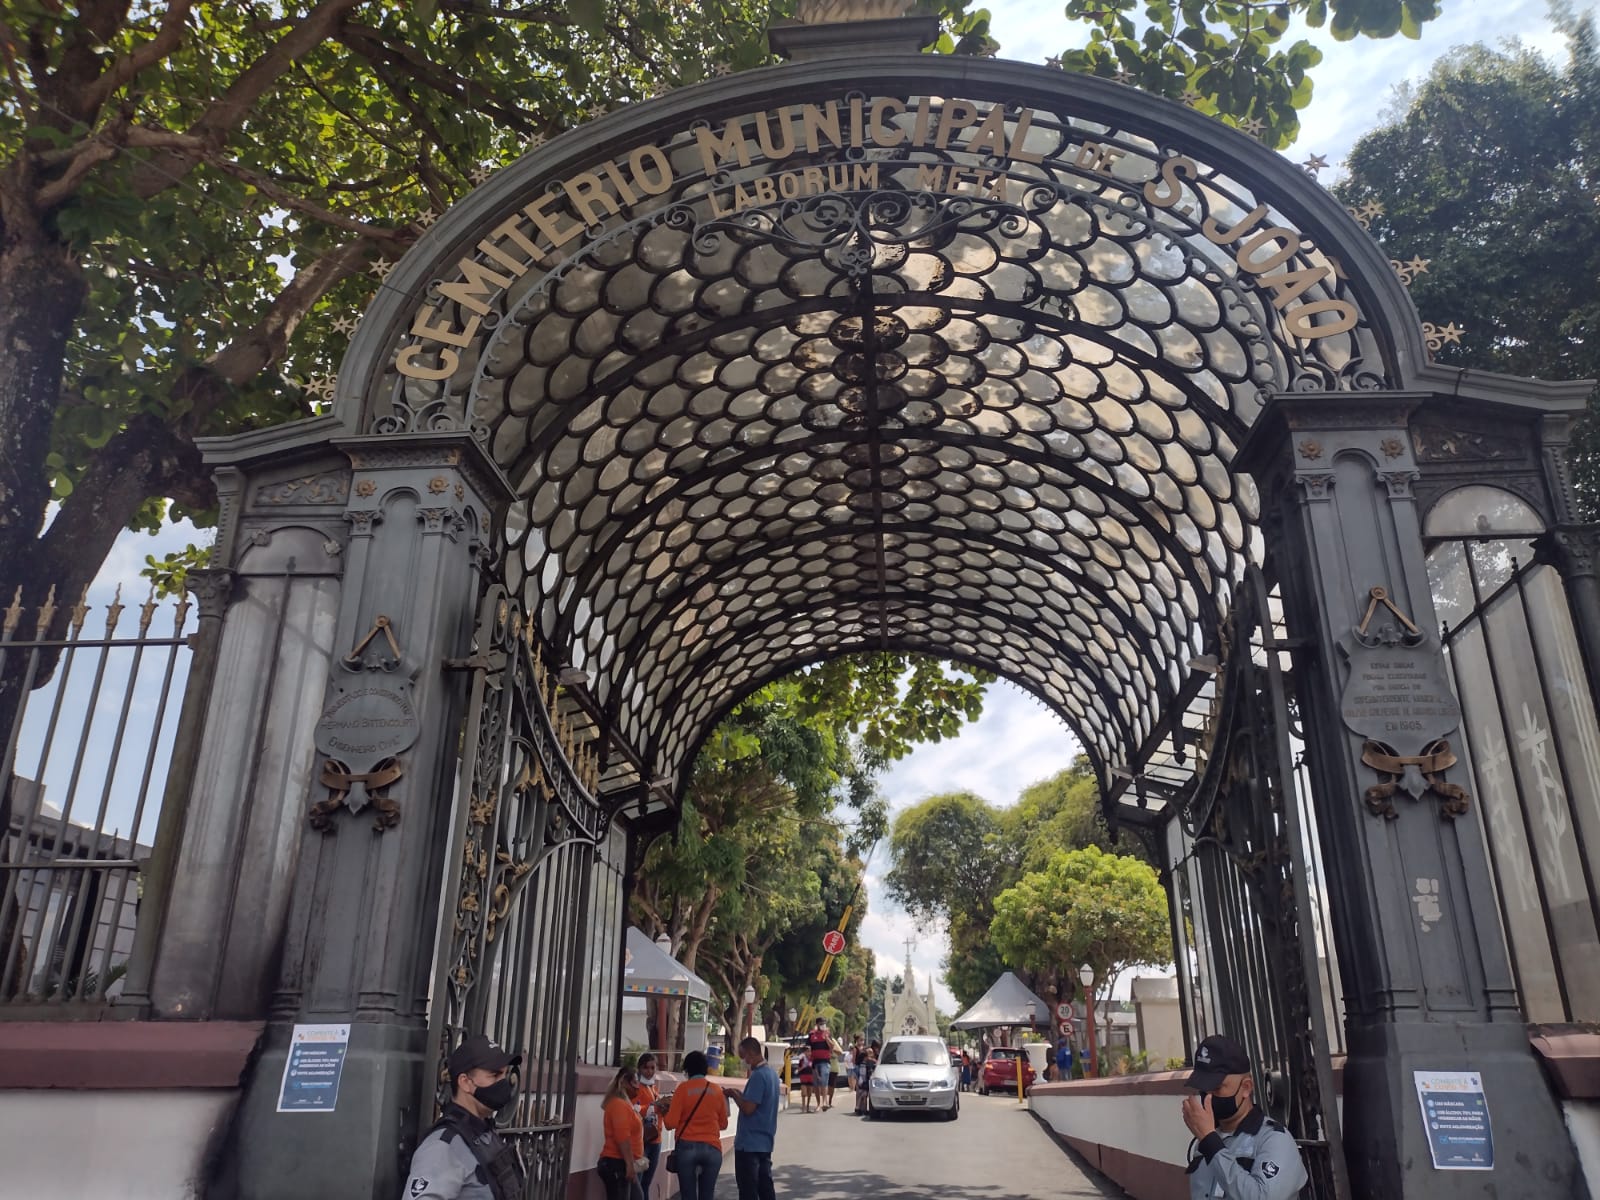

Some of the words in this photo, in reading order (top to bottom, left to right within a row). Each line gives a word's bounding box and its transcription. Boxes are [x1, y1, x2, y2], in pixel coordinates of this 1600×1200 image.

[396, 144, 674, 381] CEMITERIO
[696, 96, 1045, 176] MUNICIPAL
[1073, 140, 1127, 179] DE
[1144, 157, 1197, 217] S.
[1201, 203, 1358, 339] JOÃO
[709, 163, 879, 219] LABORUM
[916, 164, 1008, 203] META
